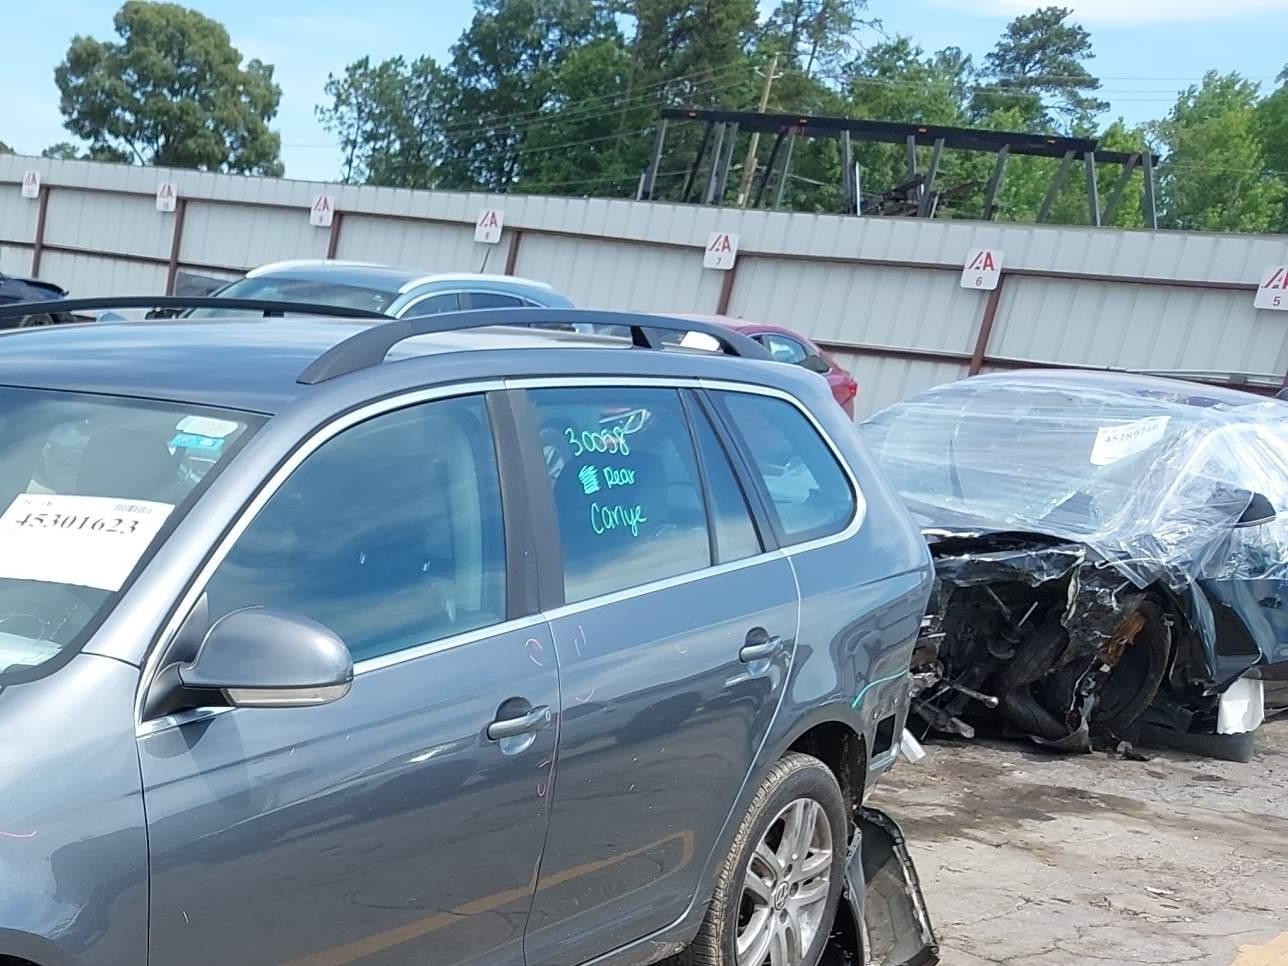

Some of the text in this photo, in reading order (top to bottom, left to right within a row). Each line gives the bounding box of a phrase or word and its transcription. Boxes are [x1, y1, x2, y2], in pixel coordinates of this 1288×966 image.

[975, 276, 982, 286] 6
[1272, 296, 1280, 306] 5
[564, 426, 630, 456] 30058
[16, 513, 140, 534] 45301623
